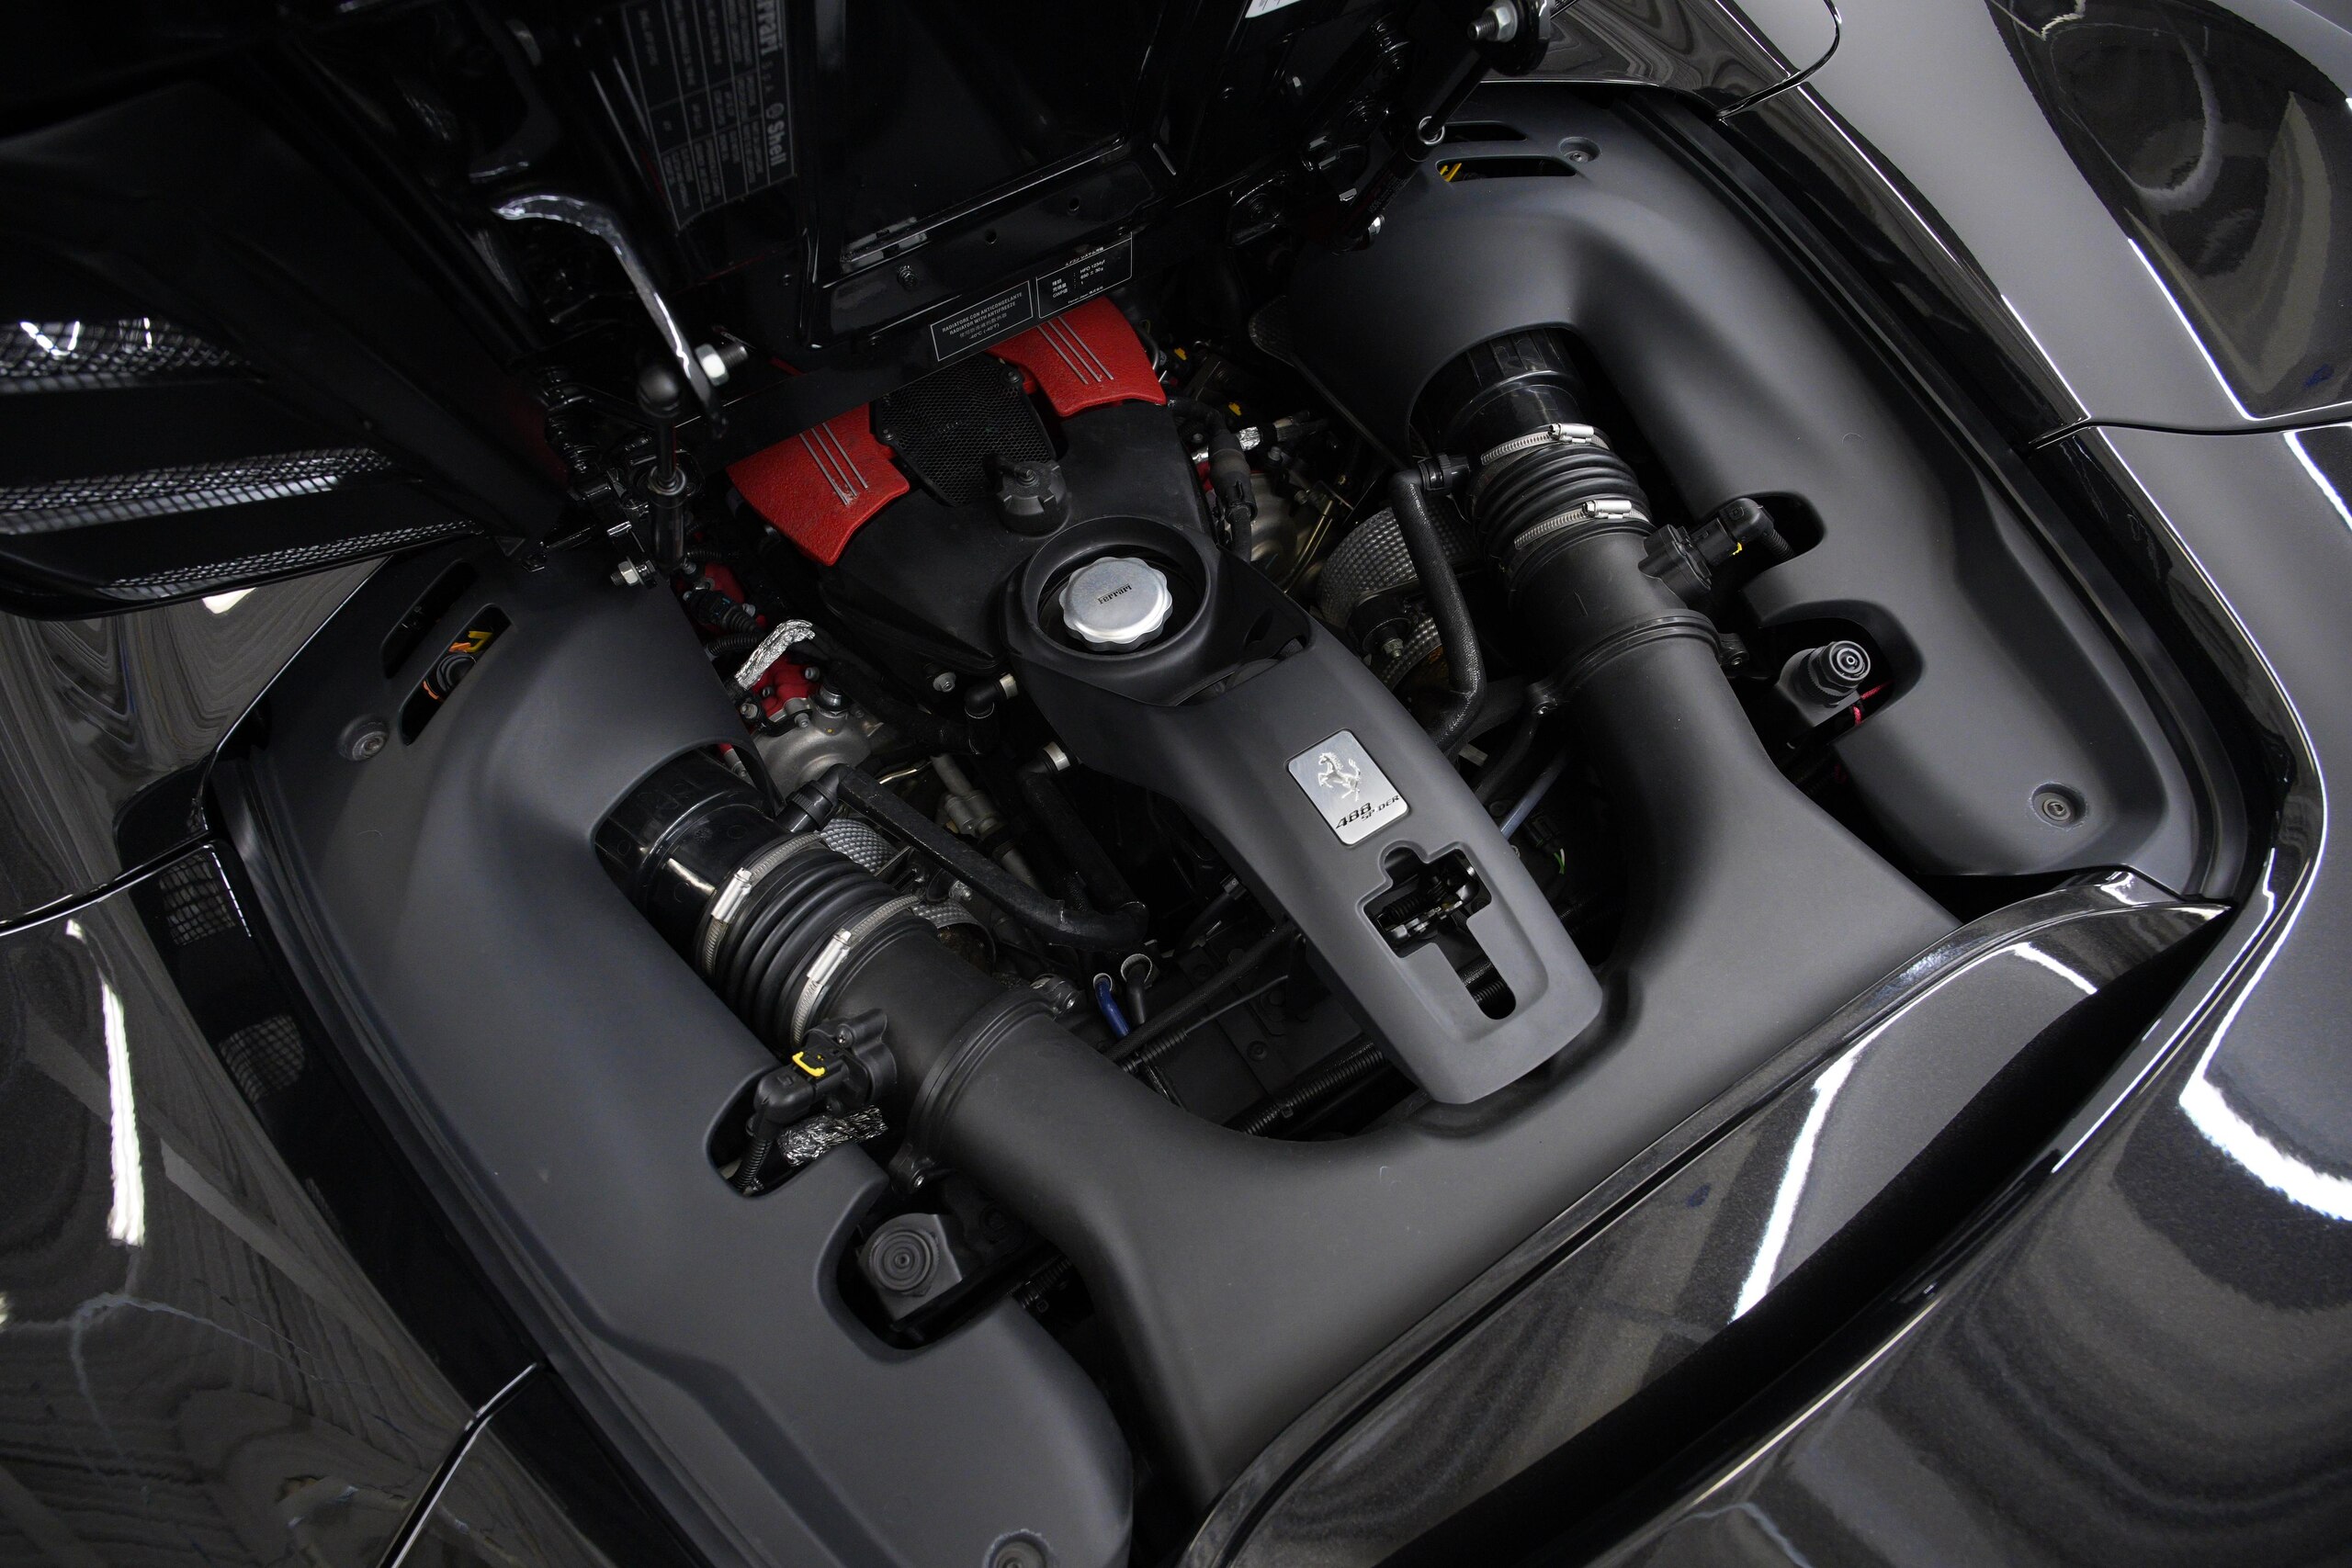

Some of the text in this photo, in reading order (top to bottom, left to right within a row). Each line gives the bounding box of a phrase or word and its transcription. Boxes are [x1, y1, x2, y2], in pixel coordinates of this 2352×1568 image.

[766, 118, 788, 167] Shell
[942, 292, 1023, 333] RADIATORE CON ANTICONGELANTE
[949, 301, 1016, 335] RADIATOR WITH ANTIFREEZE
[1097, 583, 1132, 604] Ferrari
[1335, 795, 1400, 829] 488 SPDER
